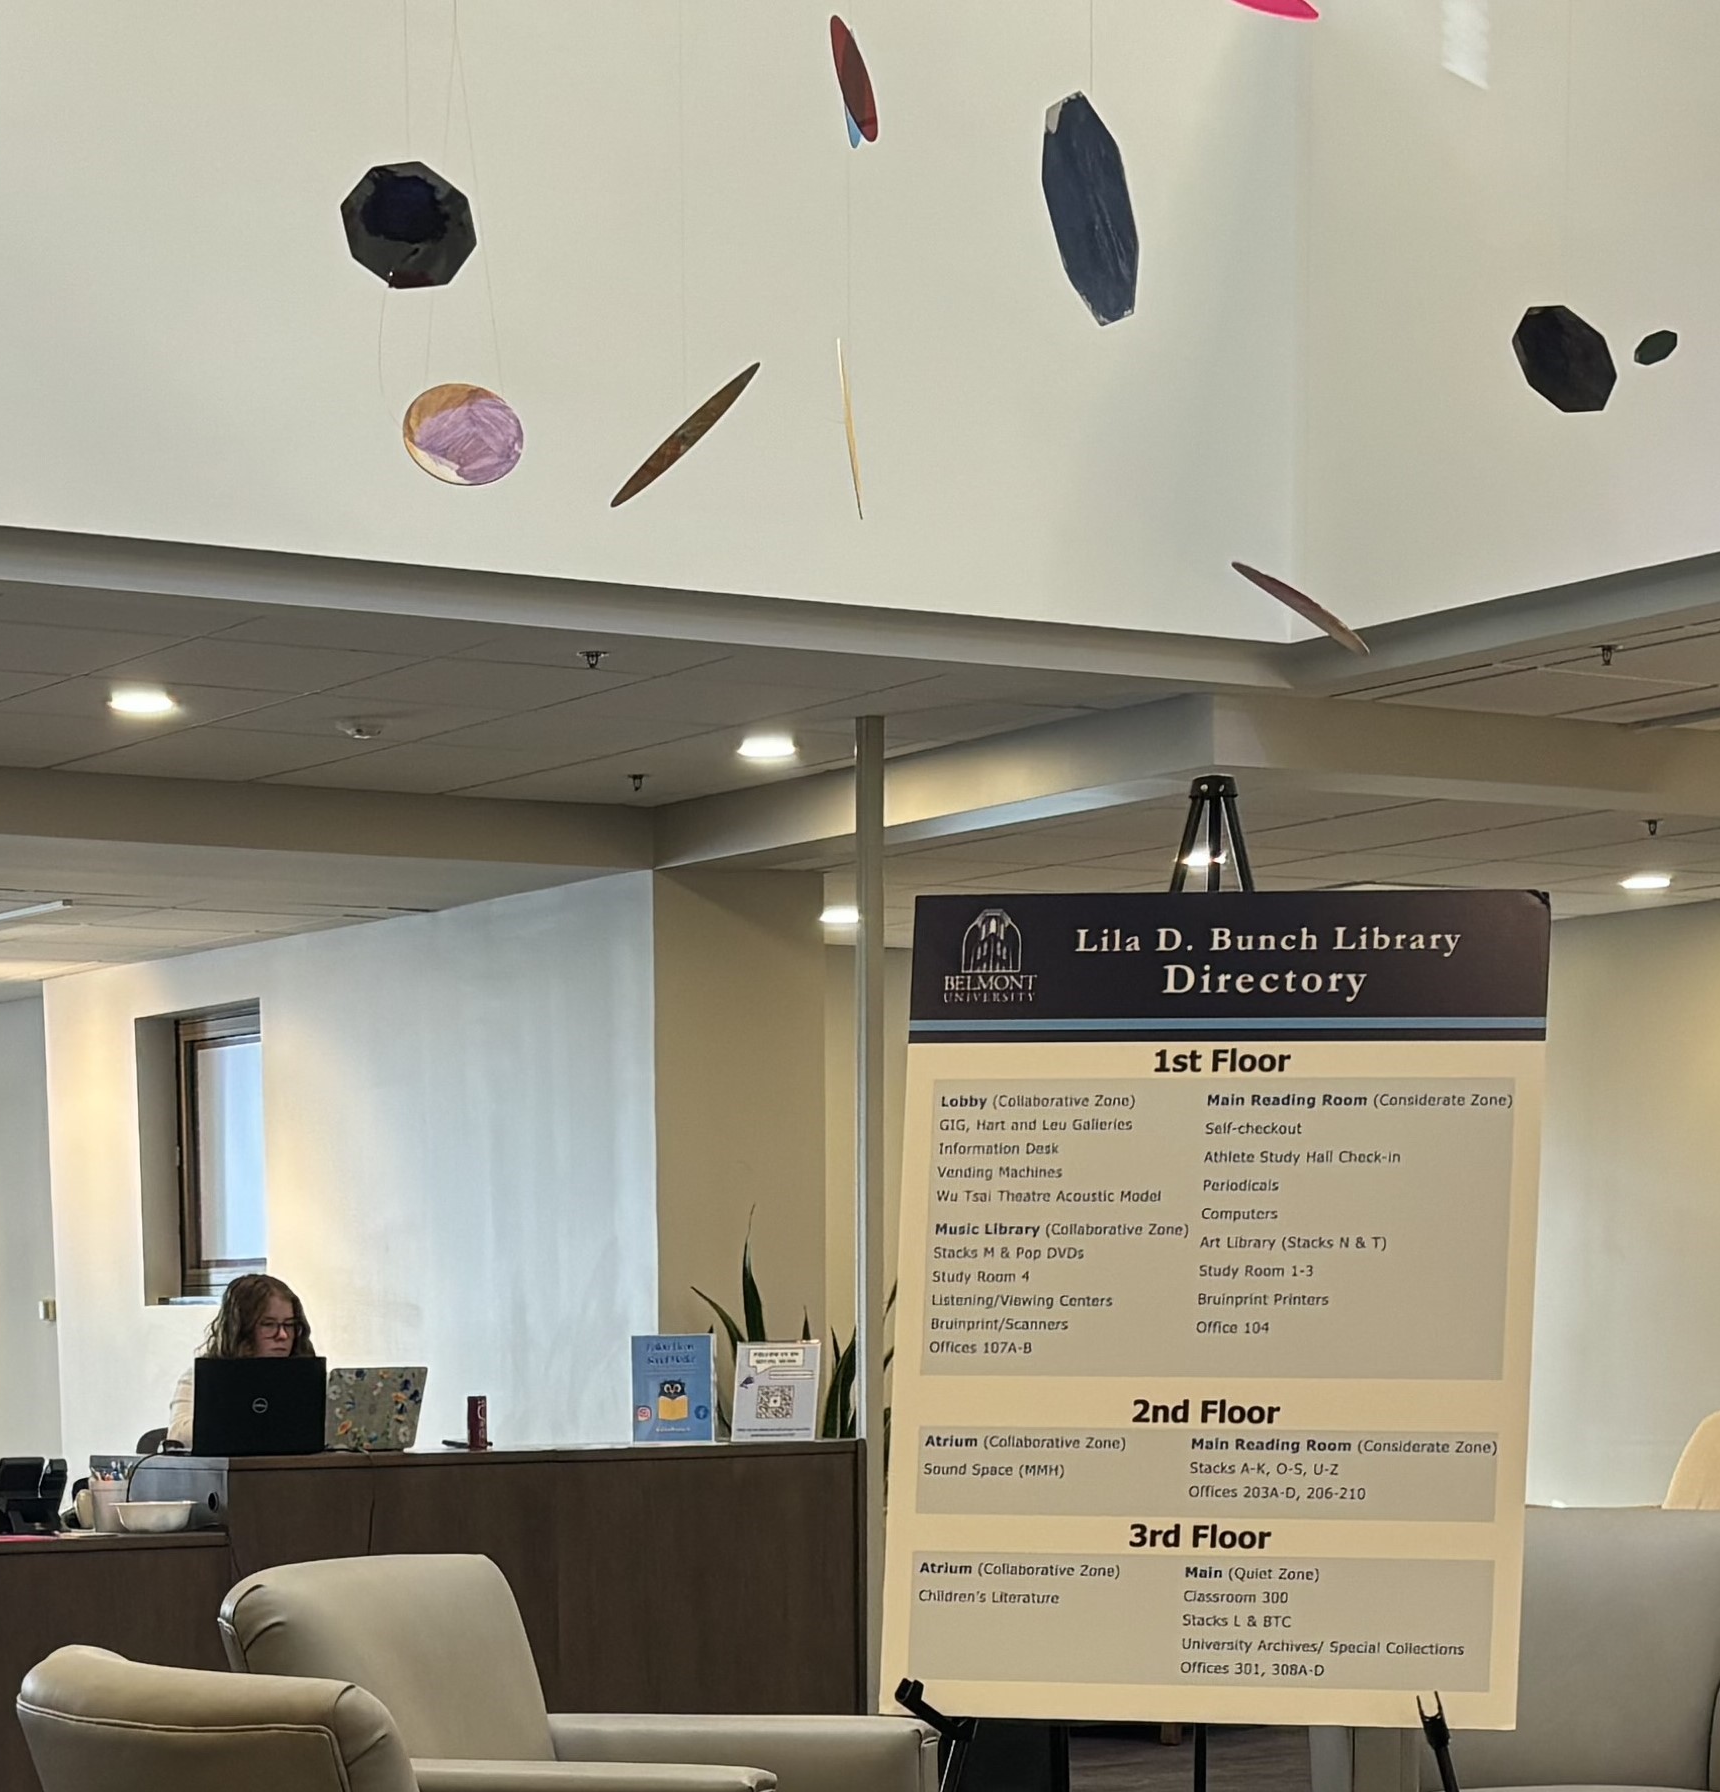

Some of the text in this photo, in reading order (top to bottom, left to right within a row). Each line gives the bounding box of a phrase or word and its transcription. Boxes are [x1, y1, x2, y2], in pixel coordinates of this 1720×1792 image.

[1075, 926, 1462, 958] Lila D. Bunch Library
[944, 974, 1038, 991] BELMONT
[1162, 964, 1368, 1003] Directory
[942, 991, 1037, 1004] UNIVERSITY
[1154, 1048, 1291, 1072] 1st Floor
[941, 1094, 1136, 1110] Lobby (Collaborative Zone)
[1207, 1093, 1513, 1109] Main Reading Room (Considerate Zone)
[939, 1117, 1133, 1133] GIG, Hart and Leu Galleries
[1205, 1121, 1302, 1135] Self-checkout
[939, 1141, 1059, 1156] Information Desk
[1203, 1150, 1401, 1166] Athlete Study Hall Check-in
[936, 1165, 1063, 1182] Vending Machines
[1203, 1179, 1279, 1192] Periodicals
[936, 1189, 1162, 1203] Wu Tsai Theatre Acoustic Model
[1201, 1207, 1278, 1223] Computers
[935, 1222, 1189, 1239] Music Library (Collaborative Zone)
[1199, 1235, 1387, 1252] Art Library (Stacks N & T)
[933, 1246, 1085, 1261] Stacks M & Pop DVDs
[931, 1270, 1030, 1285] Study Room 4
[1199, 1264, 1314, 1280] Study Room 1-3
[931, 1294, 1113, 1310] Listening/Viewing Centers
[1197, 1292, 1329, 1308] Bruinprint Printers
[930, 1317, 1069, 1333] Bruinprint/Scanners
[1195, 1320, 1270, 1335] Office 104
[929, 1340, 1033, 1355] Offices 107A-B
[1132, 1399, 1280, 1424] 2nd Floor
[924, 1434, 1126, 1452] Atrium (Collaborative Zone)
[1191, 1437, 1498, 1457] Main Reading Room (Considerate Zone)
[923, 1462, 967, 1476] Sound
[971, 1463, 1014, 1478] Space
[1189, 1461, 1339, 1477] Stacks A-K, O-S, U-Z
[1188, 1484, 1366, 1502] Offices 203A-D, 206-210
[1129, 1524, 1271, 1549] 3rd Floor
[919, 1561, 1120, 1580] Atrium (Collaborative Zone)
[1185, 1566, 1320, 1584] Main (Quiet Zone)
[918, 1589, 1060, 1605] Children's Literature
[1183, 1589, 1289, 1604] Classroom 300
[1182, 1613, 1292, 1629] Stacks L & BTC
[1181, 1637, 1465, 1656] University Archives/ Special Collections
[1180, 1661, 1325, 1678] Offices 301, 308A-D
